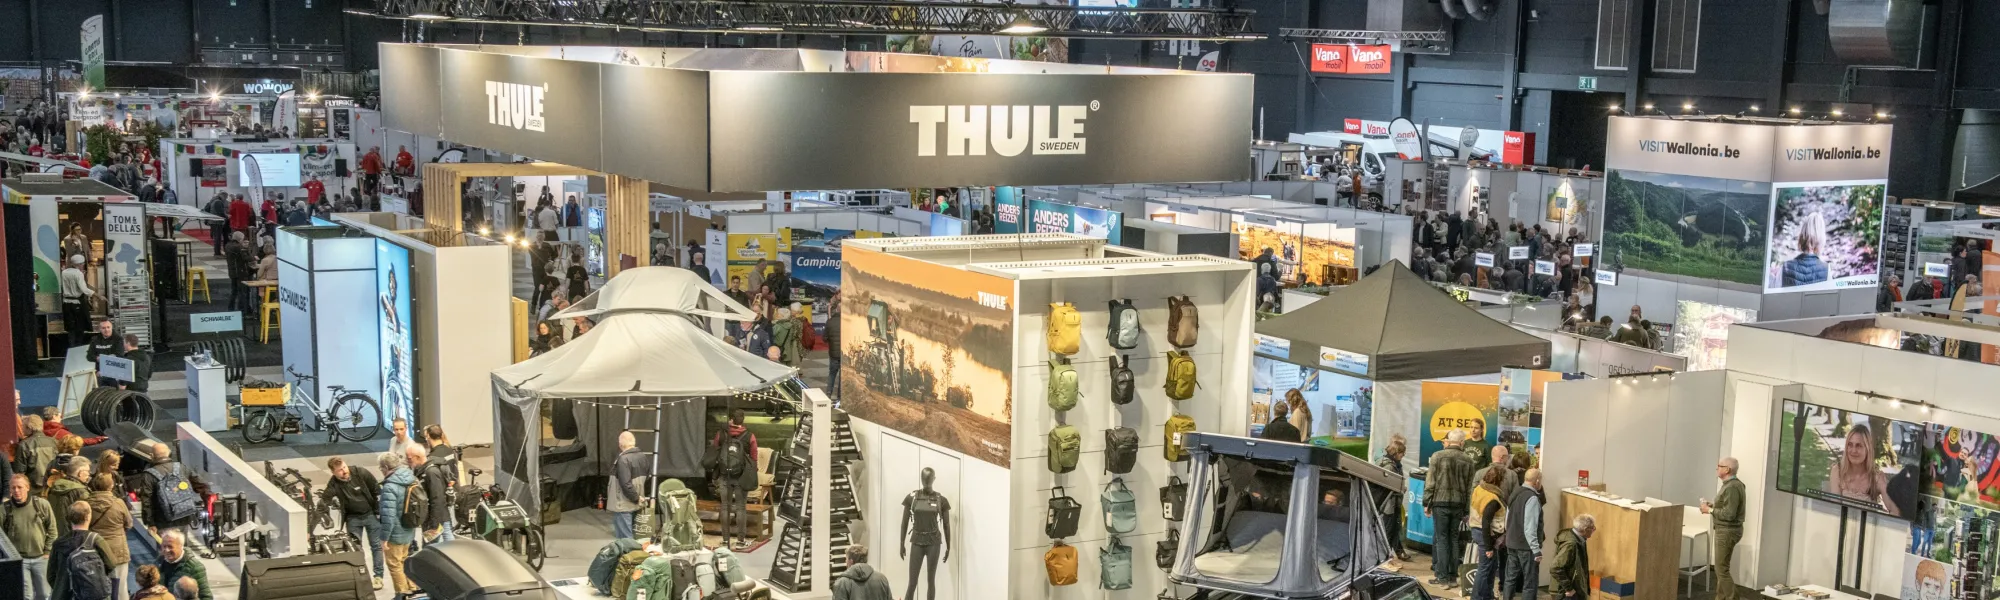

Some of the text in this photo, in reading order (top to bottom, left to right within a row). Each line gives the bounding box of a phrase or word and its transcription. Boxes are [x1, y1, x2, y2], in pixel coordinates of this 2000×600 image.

[1315, 48, 1340, 61] Vano
[1352, 48, 1383, 62] Vano
[485, 80, 545, 132] THULE
[910, 105, 1087, 156] THULE
[1345, 121, 1359, 130] Vano
[1367, 124, 1387, 134] Vano
[1505, 134, 1521, 143] Vano
[1039, 142, 1079, 150] SWEDEN
[1639, 140, 1740, 159] VISITWallonia.be
[1786, 146, 1881, 161] VISITWallonia.be
[997, 203, 1021, 216] ANDERS
[112, 216, 131, 224] TOM
[999, 213, 1019, 224] REIZEN
[1033, 209, 1069, 228] ANDERS
[796, 256, 841, 270] Camping
[1835, 279, 1877, 287] VISITWallonia.be
[280, 286, 306, 312] SCHWALBE
[977, 291, 1006, 310] THULE
[1438, 417, 1473, 428] AT SE
